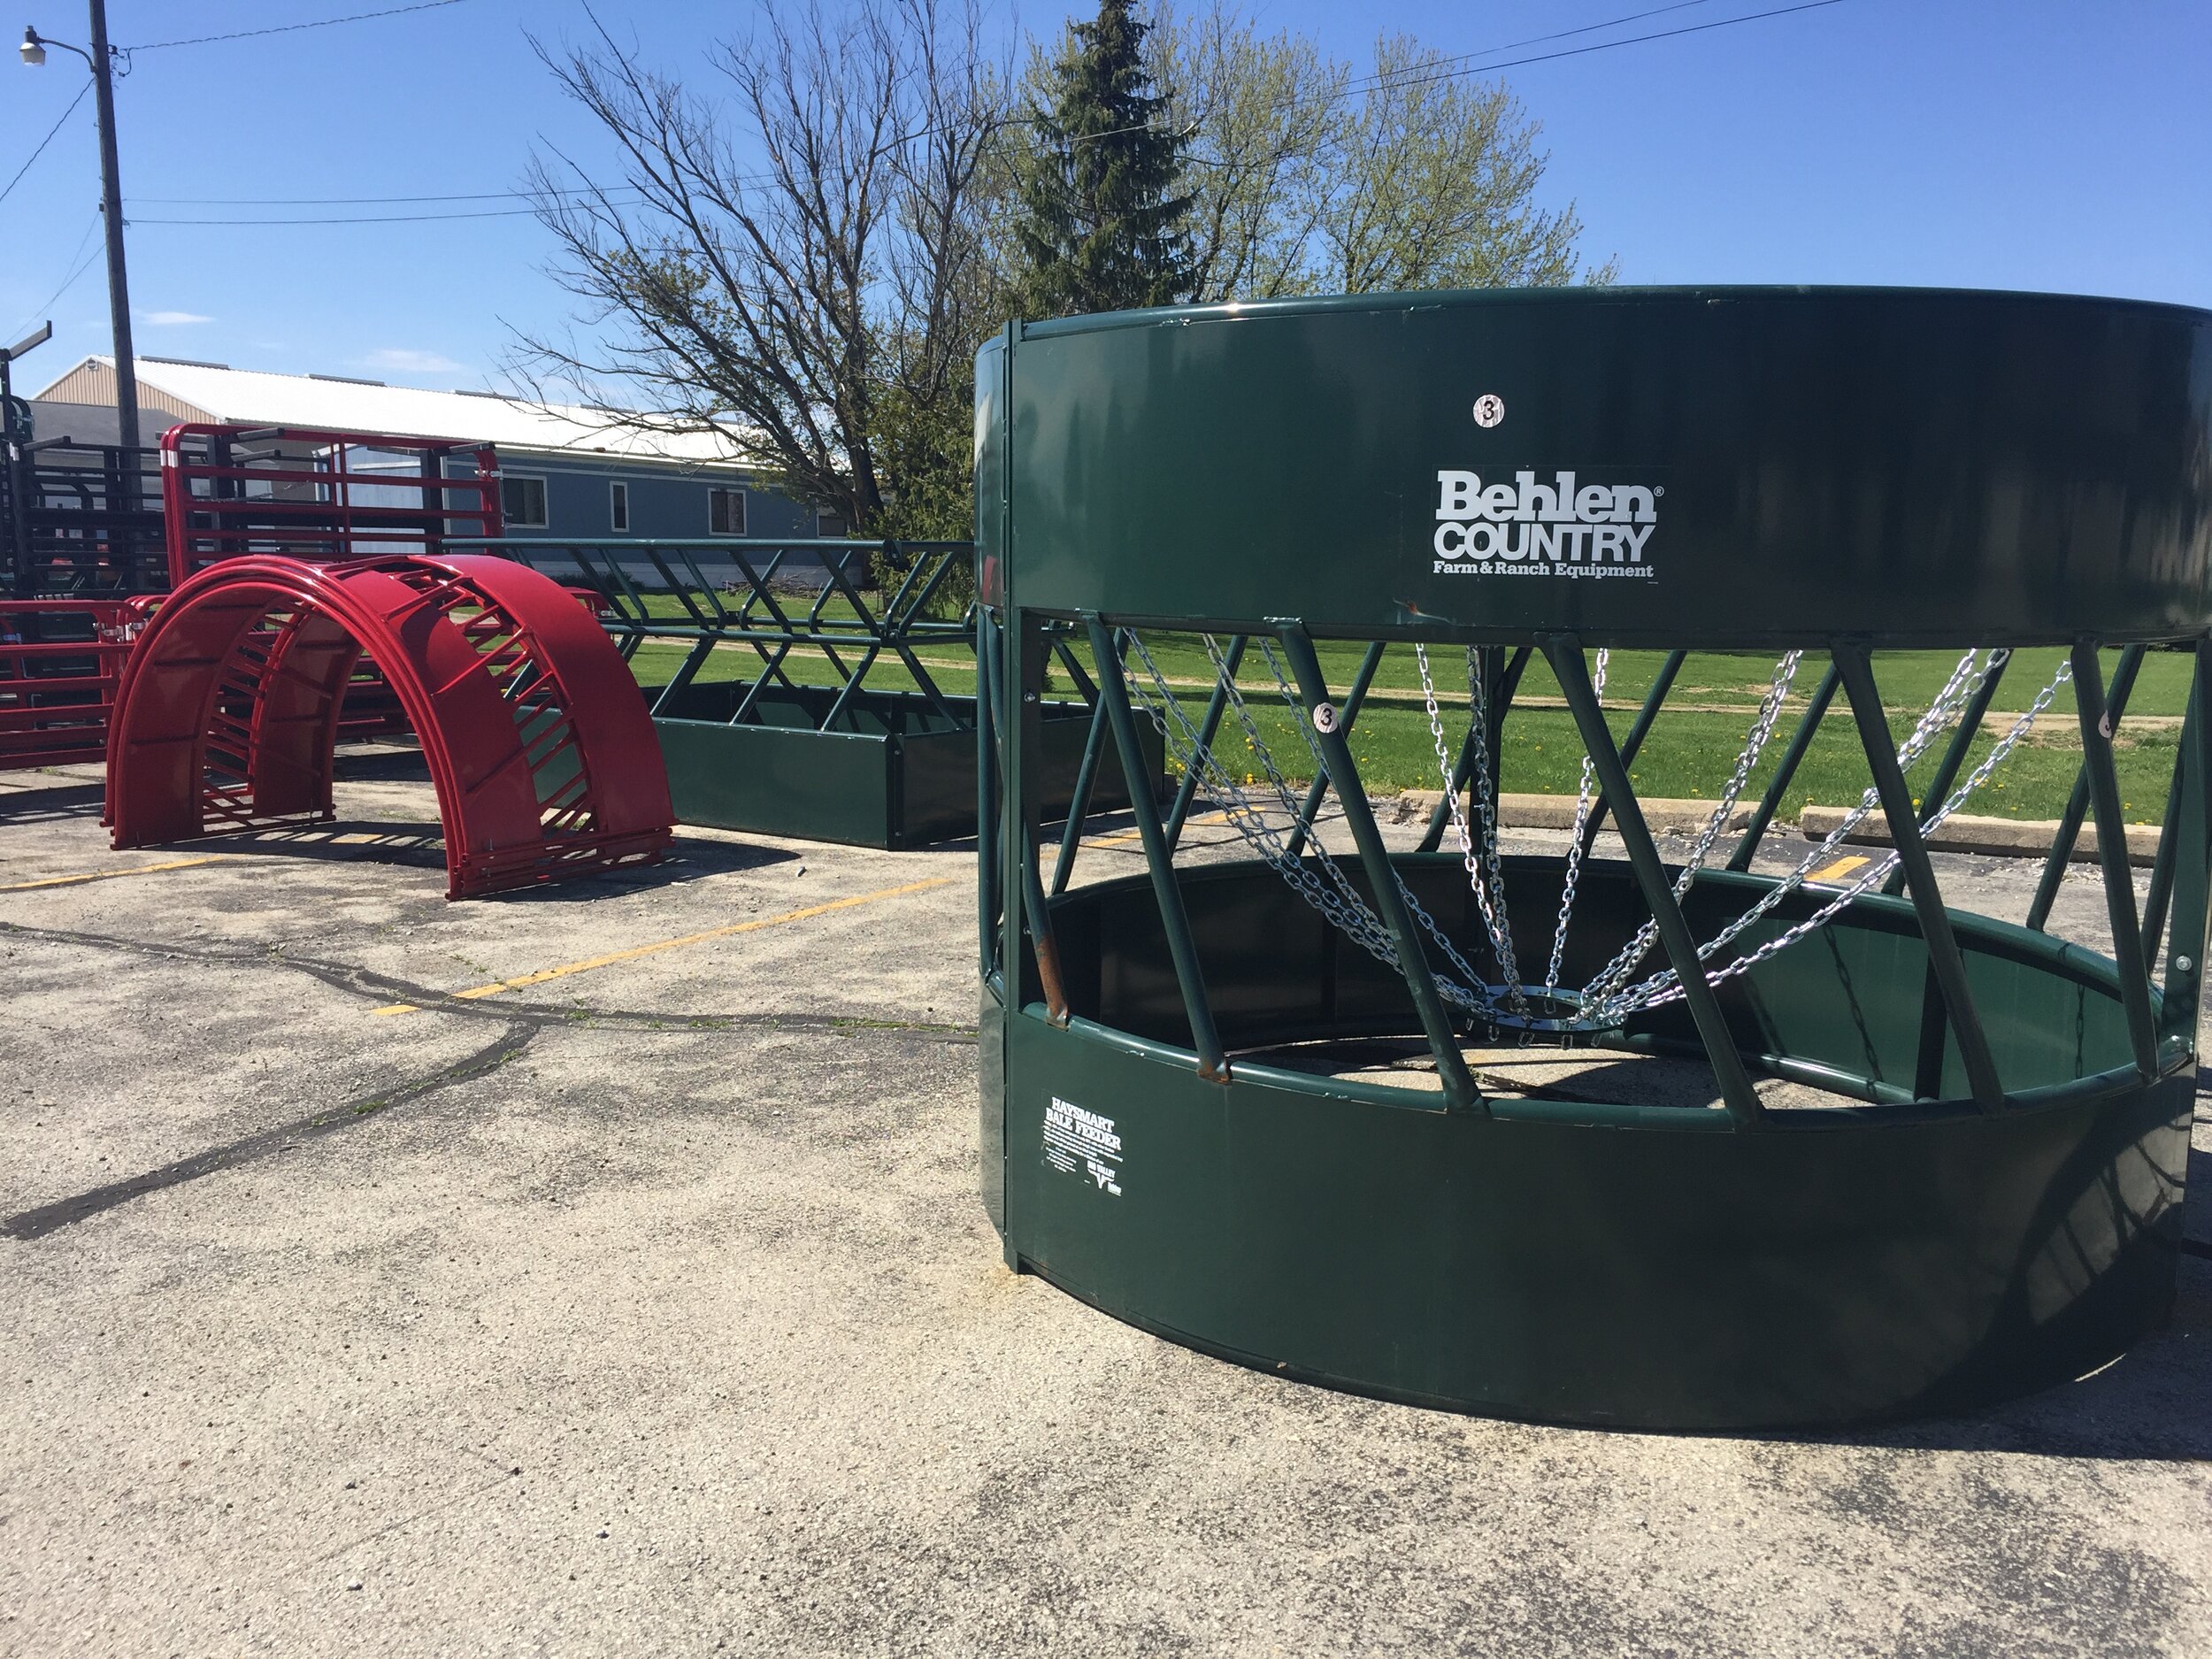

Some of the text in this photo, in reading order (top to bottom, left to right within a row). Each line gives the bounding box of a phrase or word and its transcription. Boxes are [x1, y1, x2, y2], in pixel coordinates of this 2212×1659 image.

[1483, 400, 1494, 420] 3
[1433, 522, 1656, 562] COUNTRY
[1432, 560, 1478, 574] Farm
[1494, 561, 1550, 576] Ranch
[1554, 563, 1654, 579] Equipment
[1320, 708, 1333, 726] 3
[1051, 1096, 1115, 1133] HAYSMART
[1046, 1107, 1073, 1132] BALE
[1075, 1119, 1122, 1151] FEEDER
